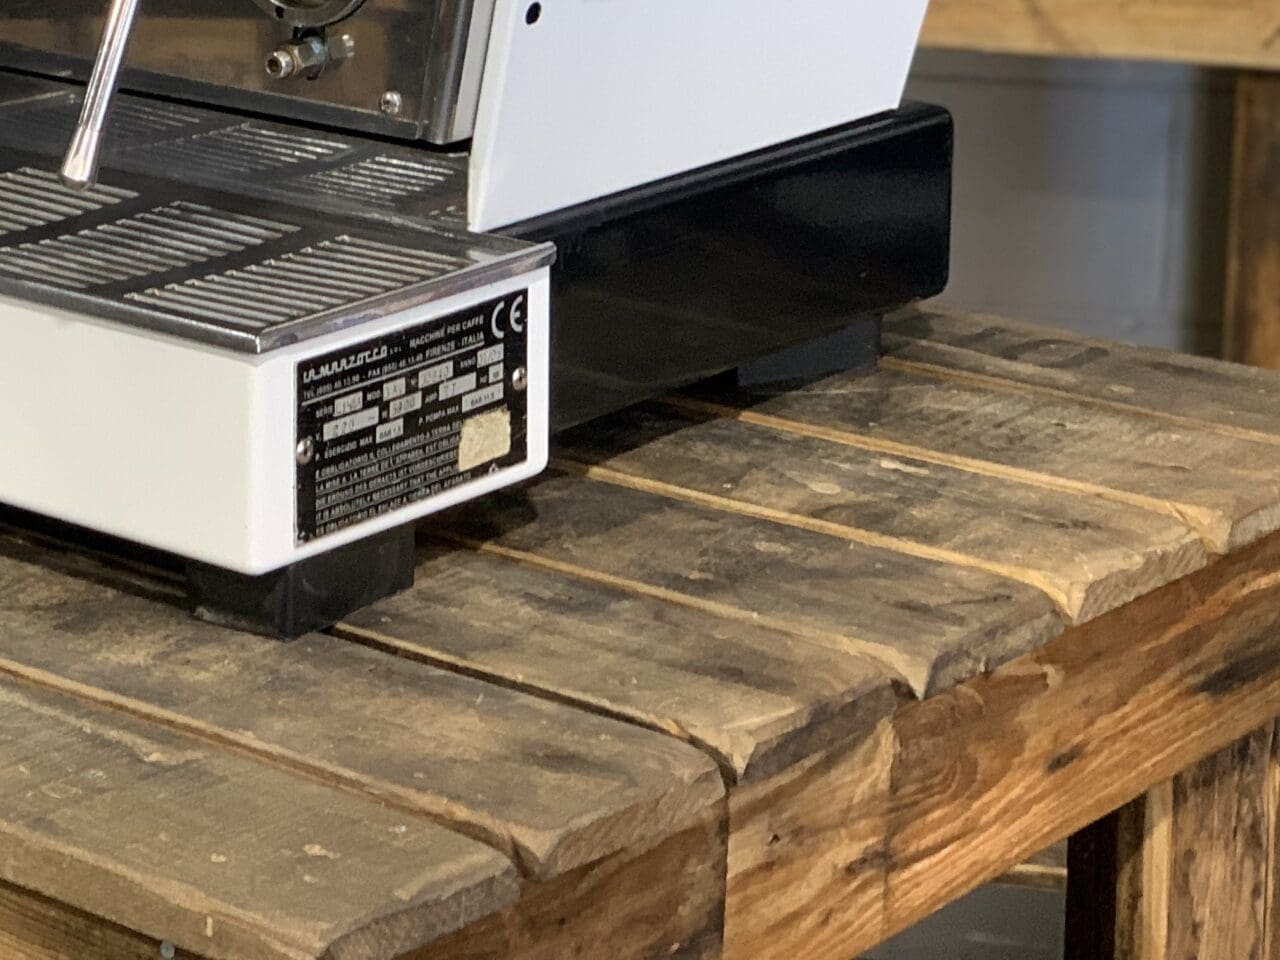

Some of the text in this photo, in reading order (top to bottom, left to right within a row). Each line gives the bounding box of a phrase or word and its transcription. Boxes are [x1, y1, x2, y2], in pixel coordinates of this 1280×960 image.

[447, 323, 460, 334] PER
[368, 368, 380, 378] FAX
[426, 341, 455, 357] FIRENZE
[462, 331, 484, 345] ITALIA
